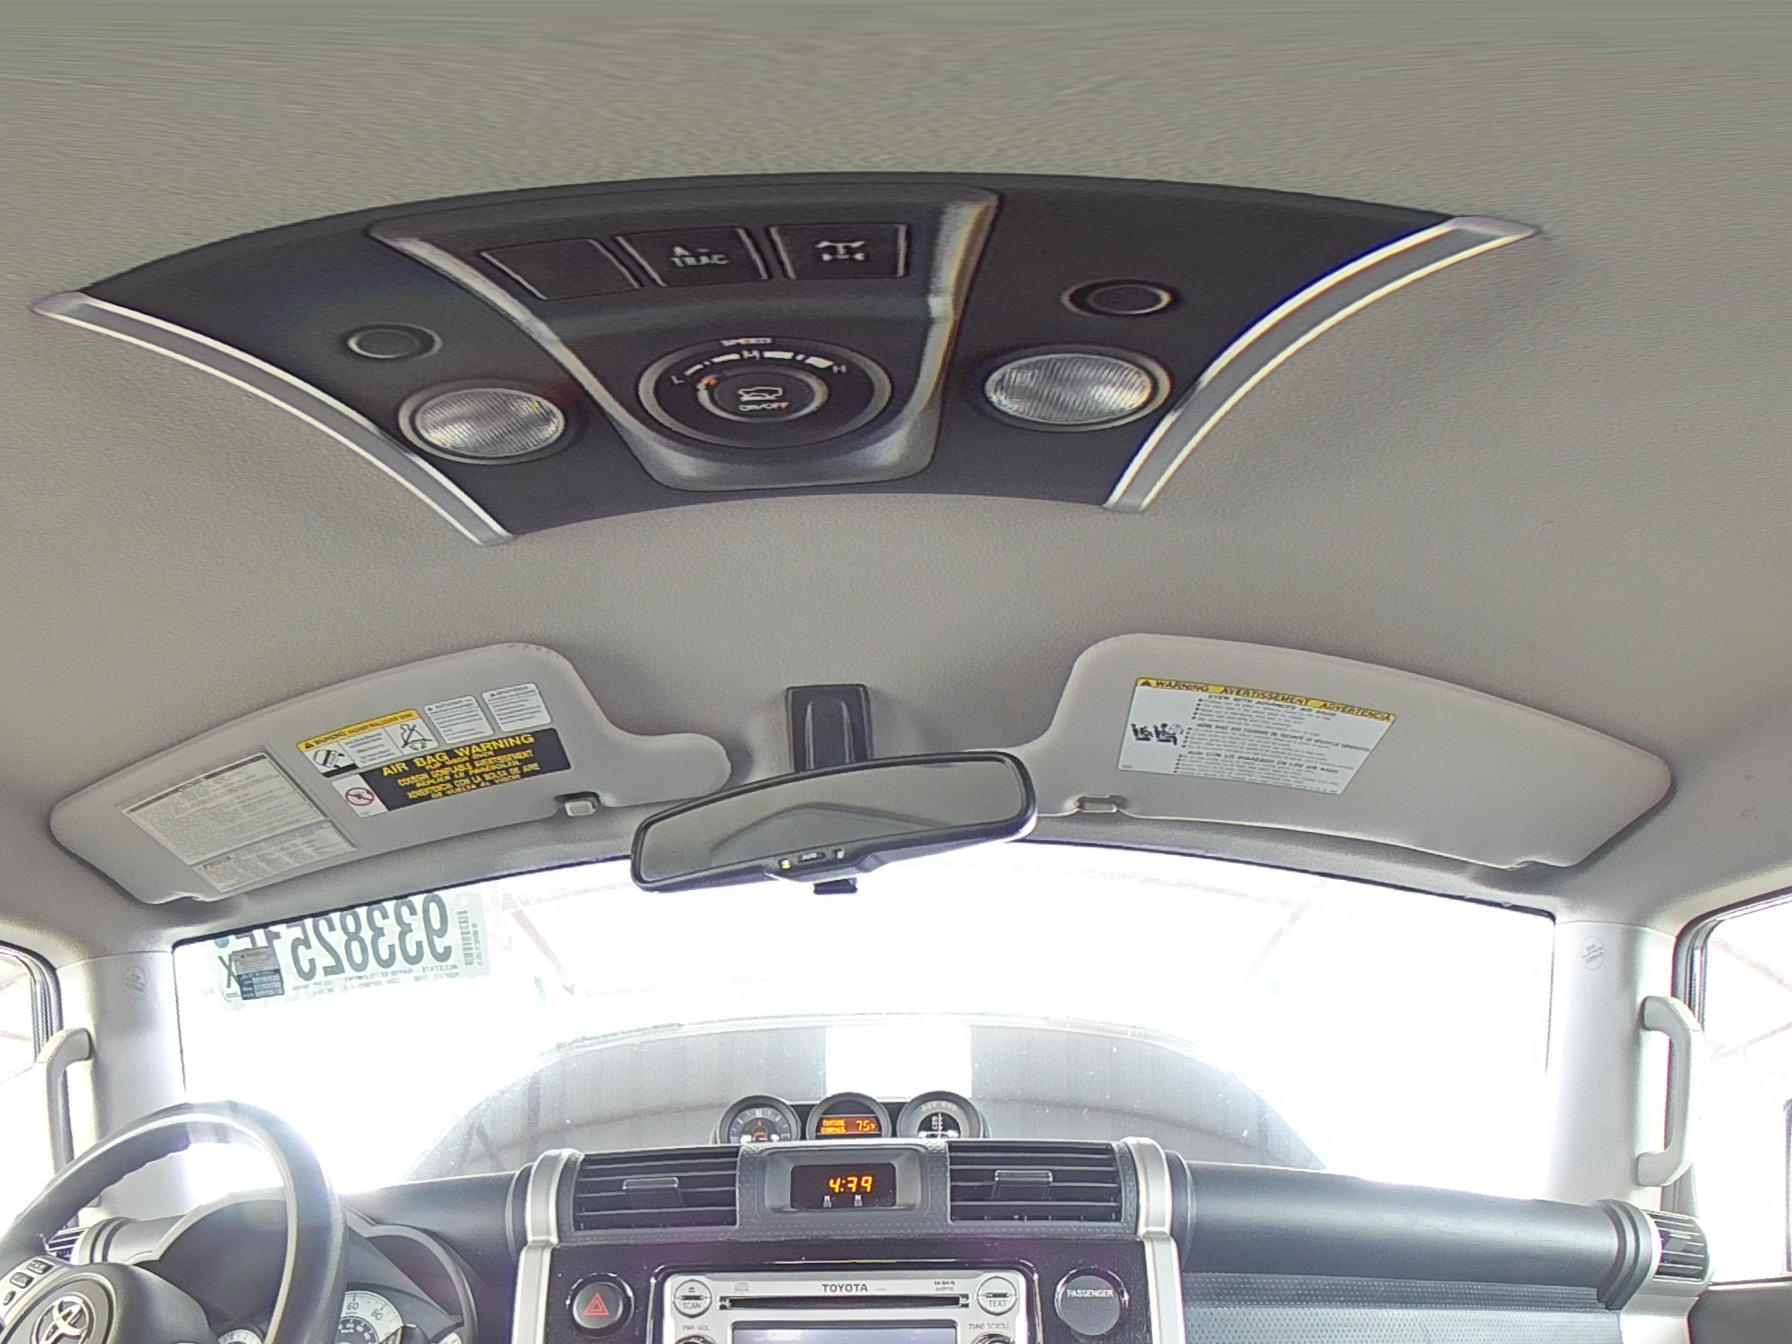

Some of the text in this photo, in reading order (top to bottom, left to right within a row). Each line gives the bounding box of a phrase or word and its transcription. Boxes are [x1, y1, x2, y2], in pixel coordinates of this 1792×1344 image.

[382, 734, 535, 777] AIR BAG WARNING
[828, 1175, 873, 1193] 4:39
[821, 1283, 868, 1293] TOYOTA
[1066, 1288, 1114, 1298] PASSENGER
[988, 1299, 1007, 1308] TEXT
